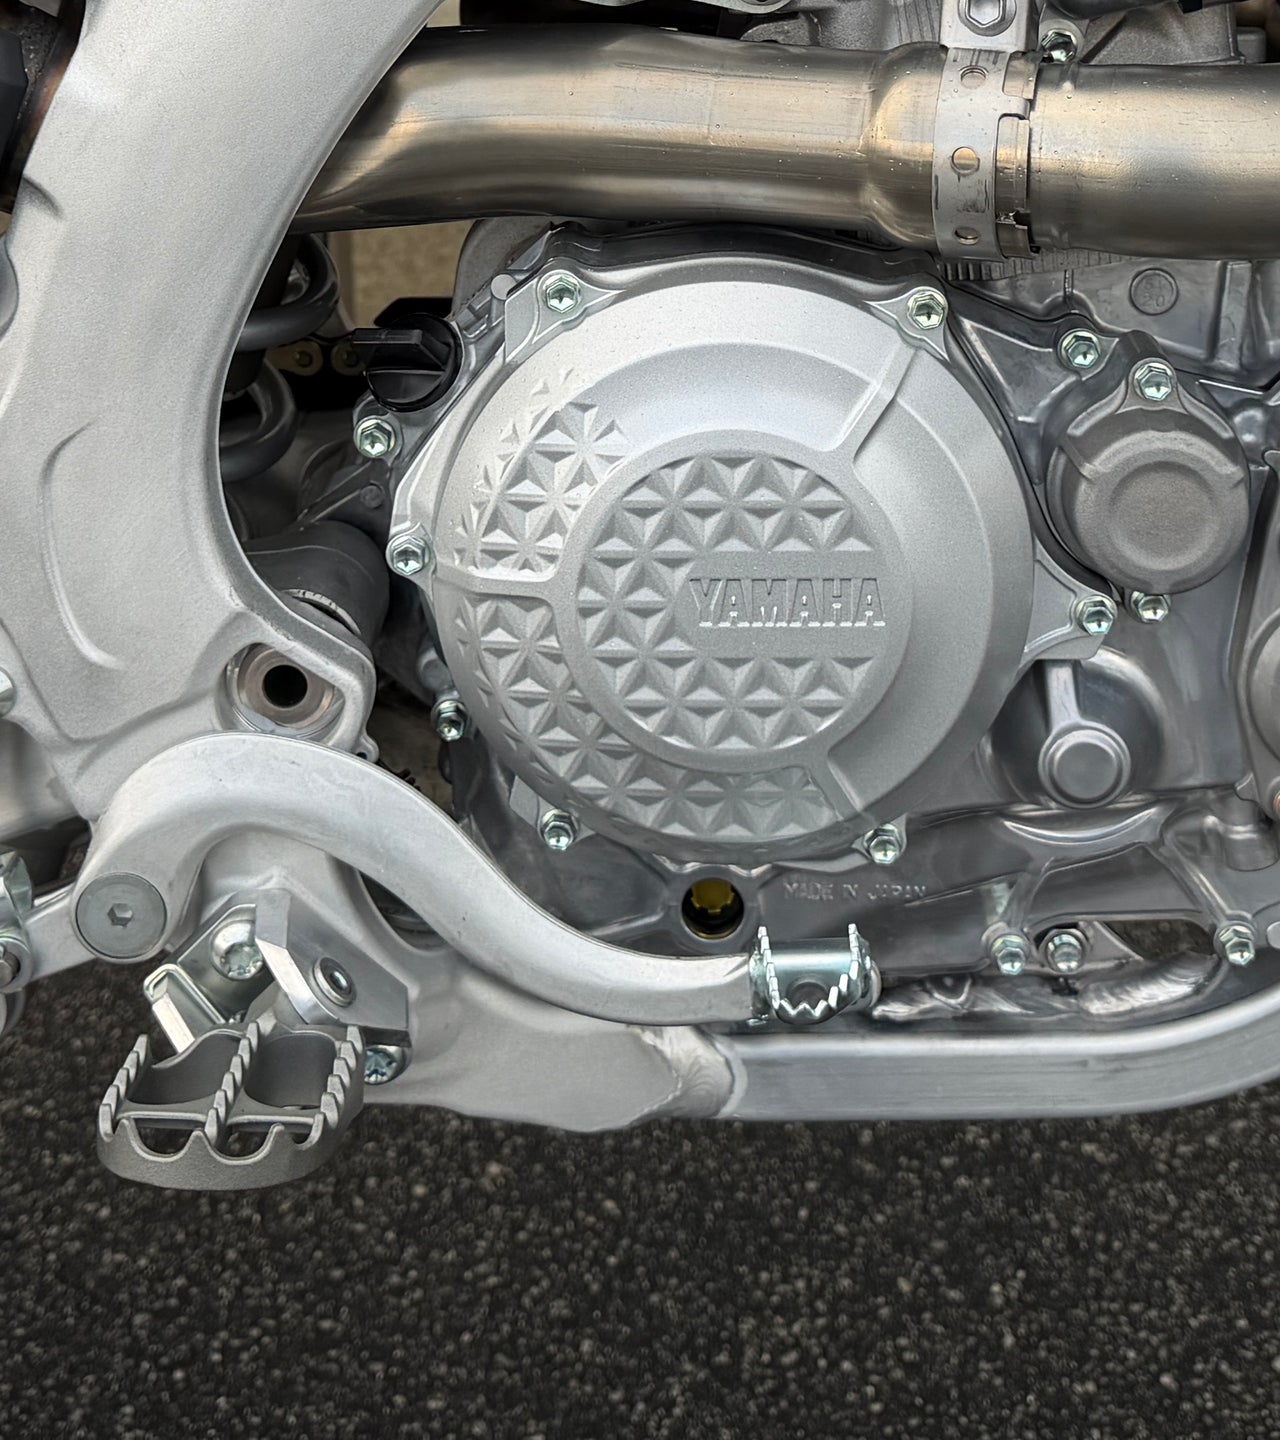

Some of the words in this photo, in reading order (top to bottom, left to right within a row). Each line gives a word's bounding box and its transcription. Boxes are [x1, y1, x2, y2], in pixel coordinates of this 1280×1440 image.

[689, 577, 886, 628] YAMAHA
[783, 881, 834, 901] MADE
[867, 883, 926, 900] JAPAN
